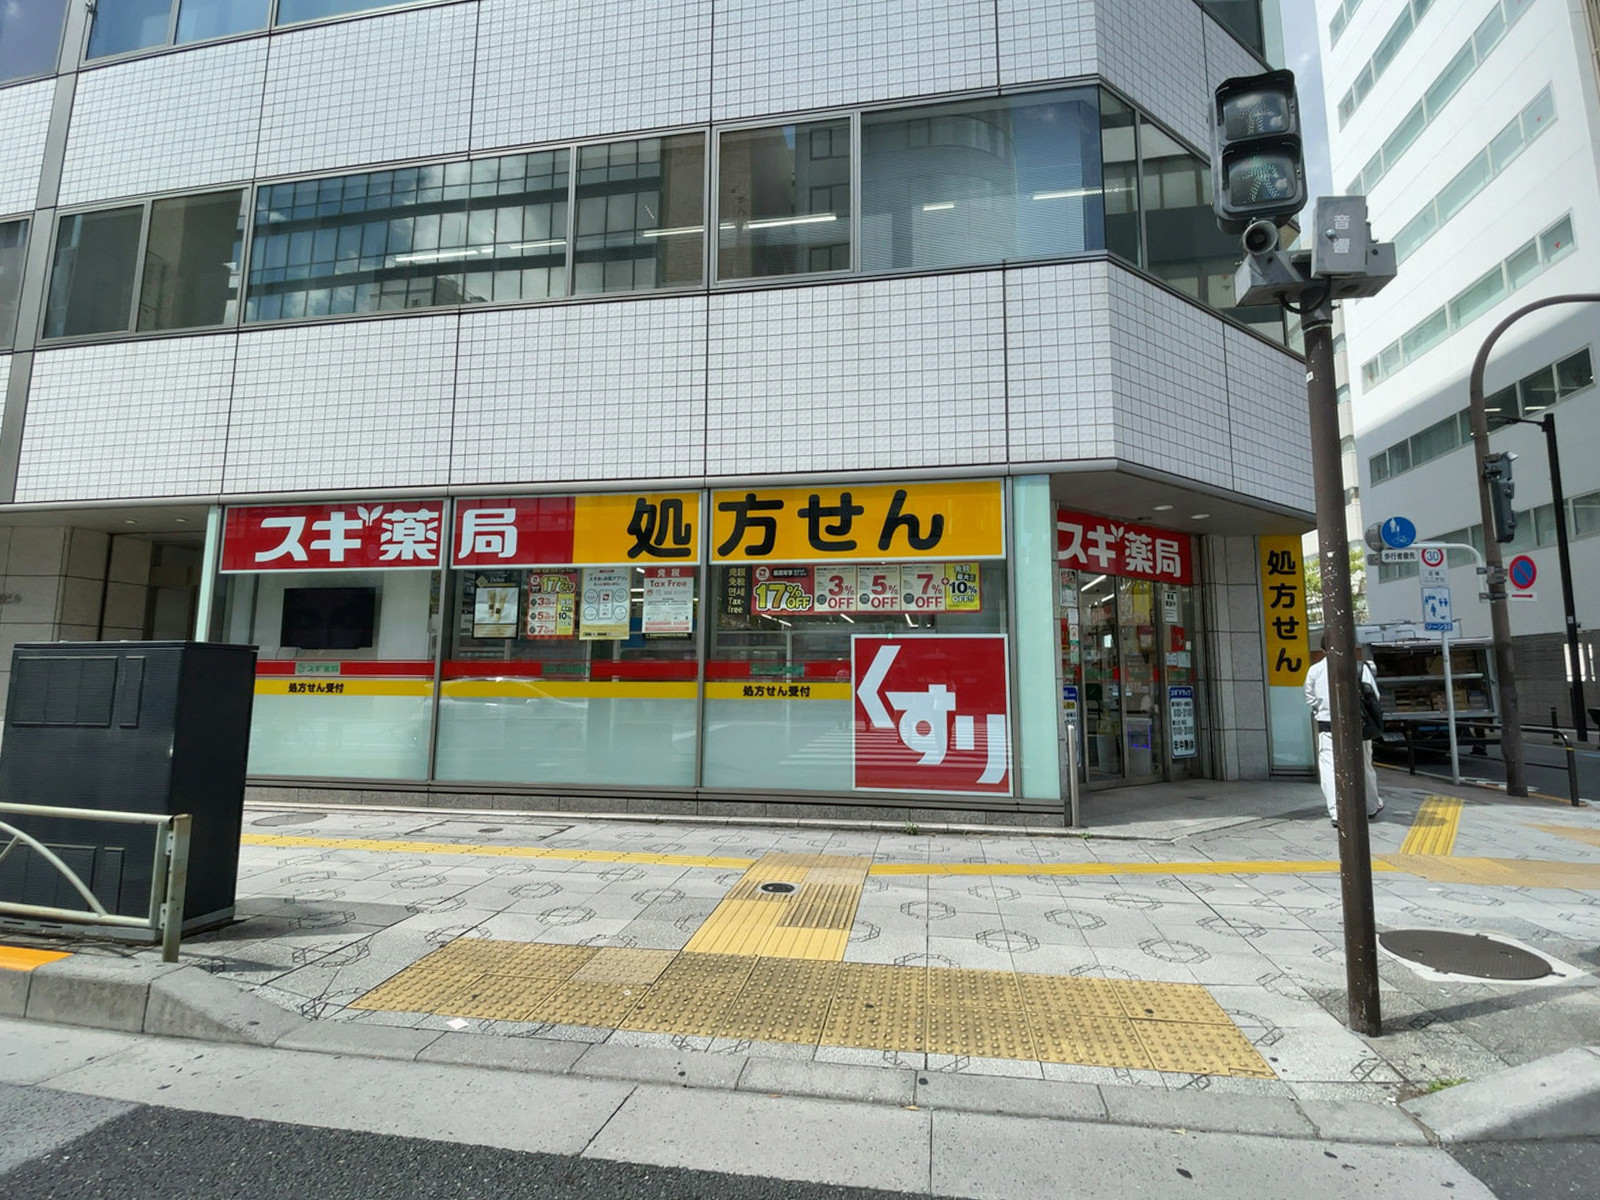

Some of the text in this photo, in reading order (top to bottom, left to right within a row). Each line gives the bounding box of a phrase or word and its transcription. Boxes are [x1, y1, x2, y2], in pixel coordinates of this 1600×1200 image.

[627, 489, 945, 560] 処方せん
[254, 504, 518, 563] スギ薬局
[1057, 521, 1181, 578] スギ薬局
[1427, 551, 1440, 561] 30
[828, 575, 854, 596] 3%
[871, 575, 898, 595] 5%
[917, 573, 942, 595] 7%
[949, 581, 977, 594] 10%
[728, 597, 744, 605] Tax-
[754, 582, 811, 609] 17% OFF
[828, 597, 854, 609] OFF
[871, 596, 898, 608] OFF
[915, 596, 943, 608] OFF
[727, 605, 743, 614] free
[1267, 550, 1302, 672] 処方せん
[288, 683, 344, 693] 処方せん受付
[742, 685, 811, 697] 処方せん受付
[856, 645, 1006, 784] くすり
